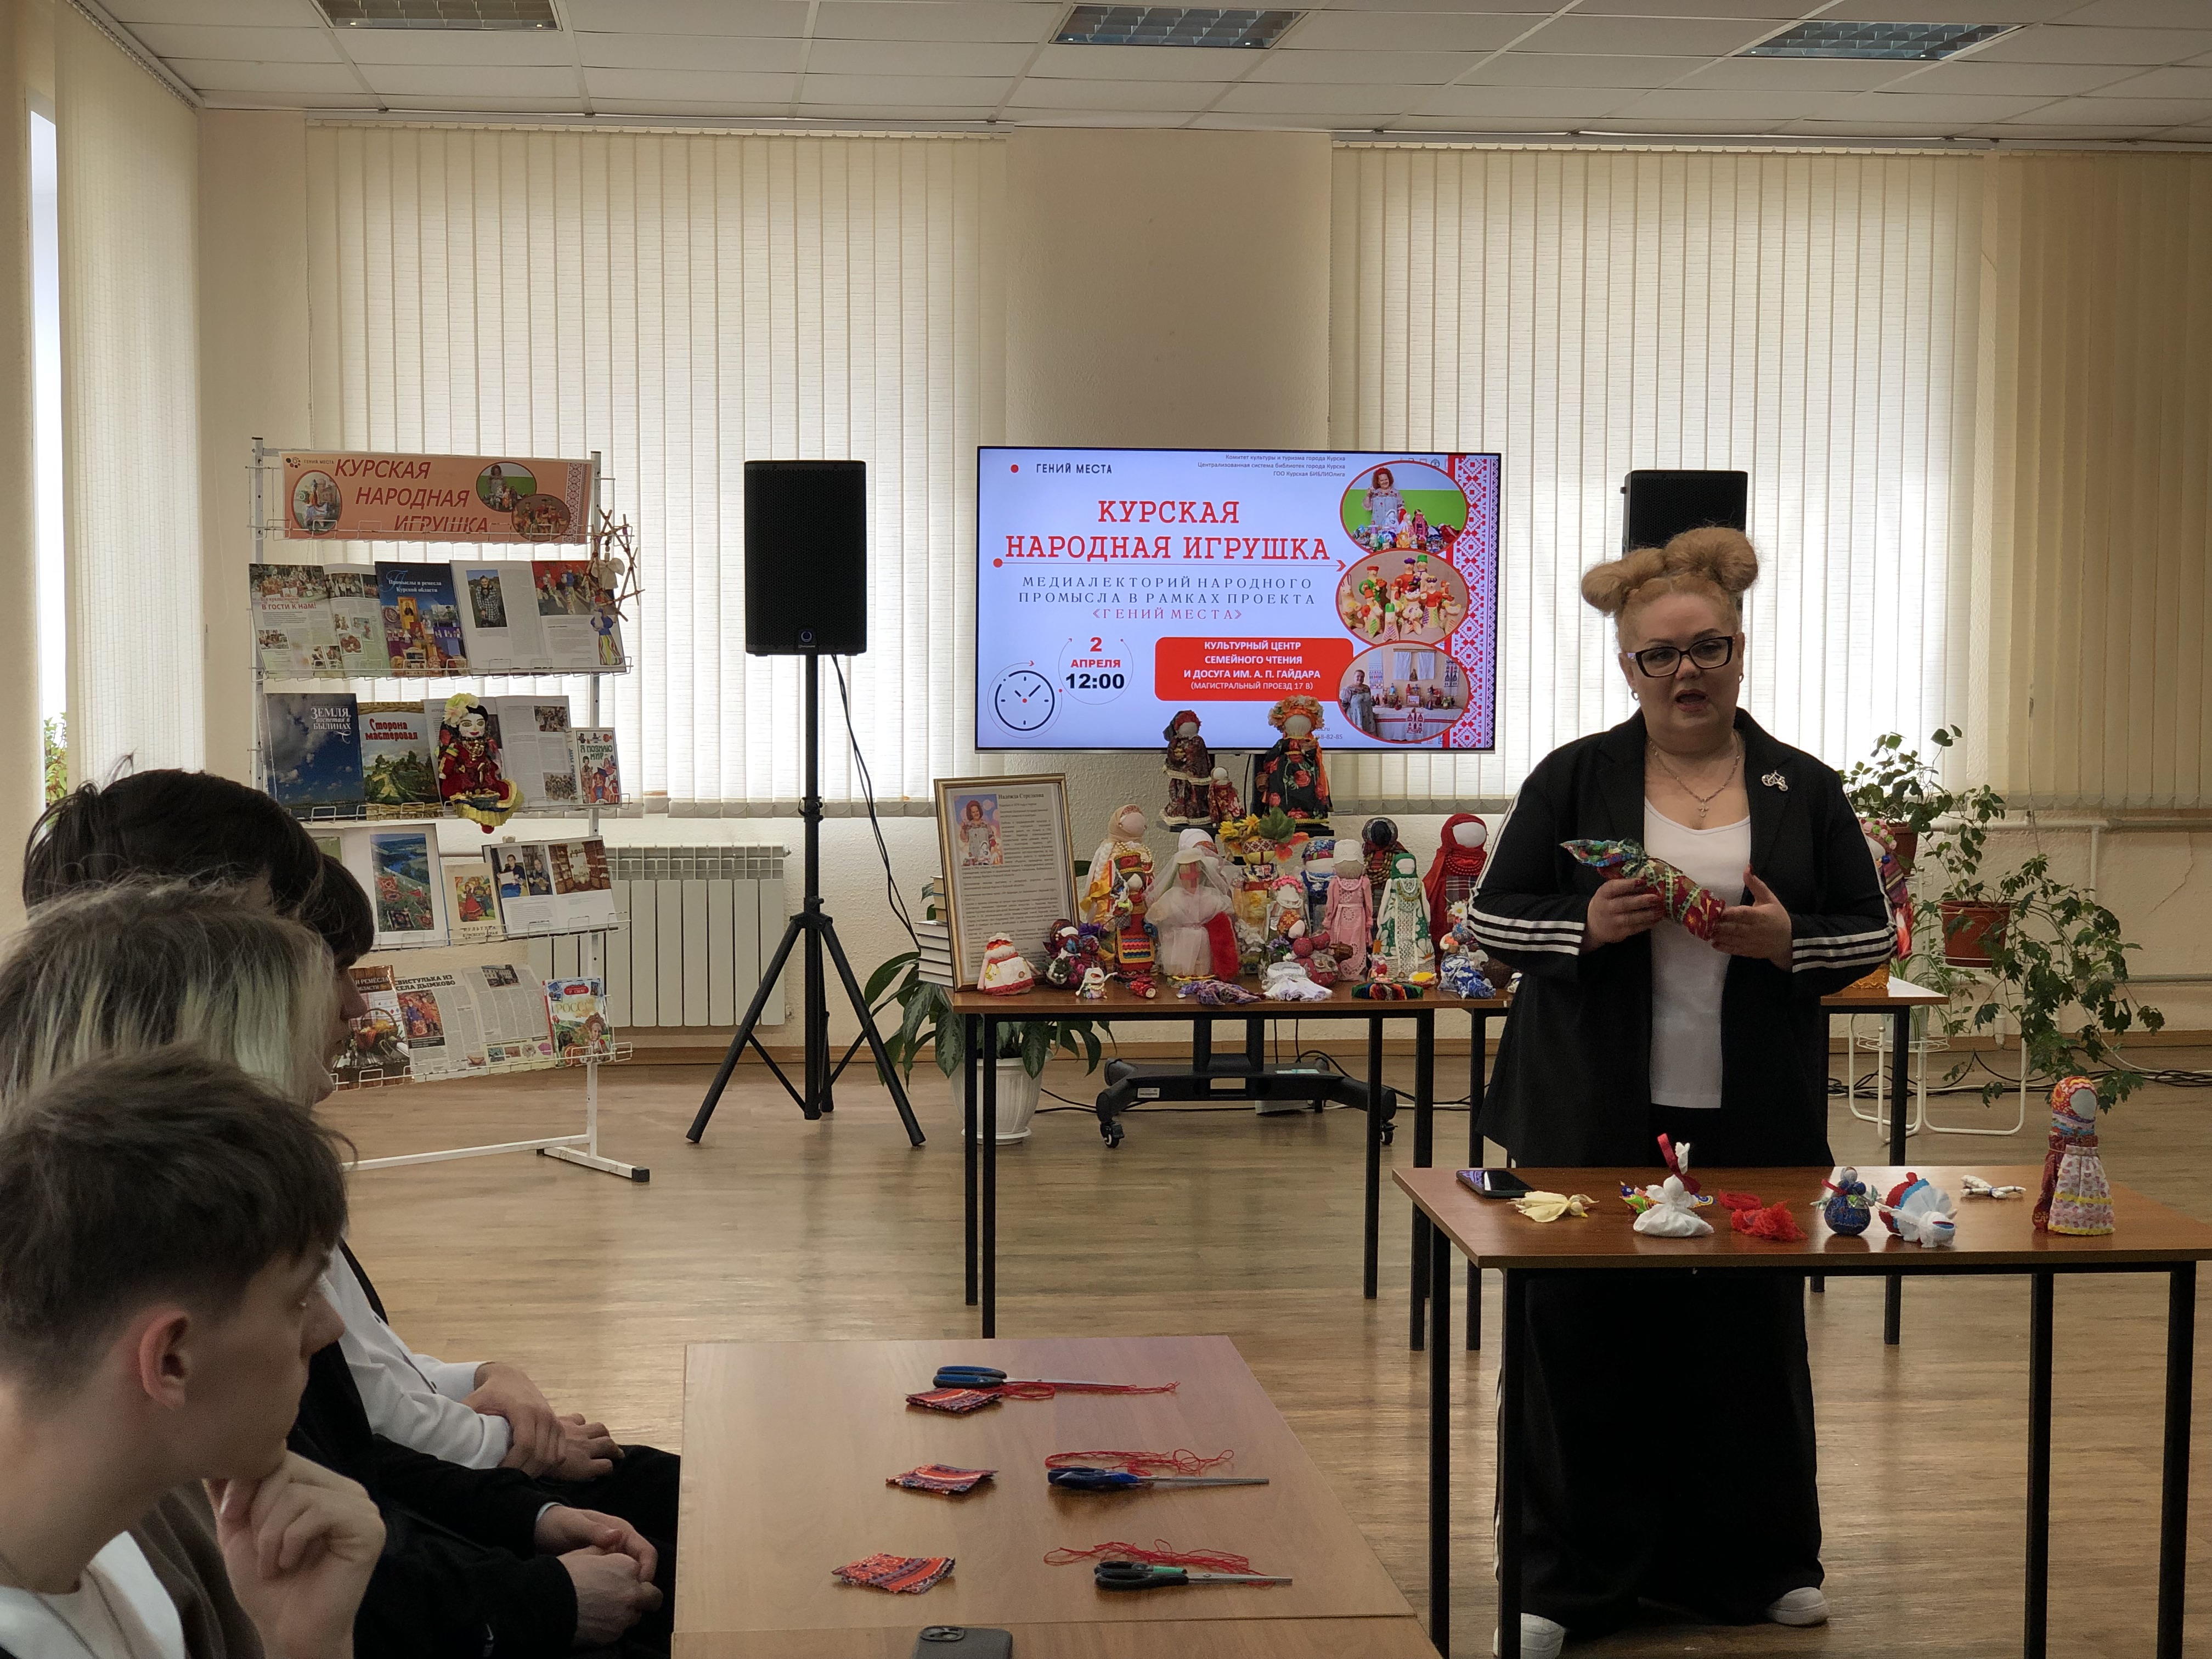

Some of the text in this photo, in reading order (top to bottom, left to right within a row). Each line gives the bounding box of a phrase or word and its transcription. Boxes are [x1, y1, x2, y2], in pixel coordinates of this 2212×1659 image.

[335, 459, 431, 479] КУРСКАЯ
[1036, 462, 1113, 474] ГЕНИЙ МЕСТА
[356, 487, 470, 510] НАРОДНАЯ
[1098, 500, 1240, 523] КУРСКАЯ
[394, 515, 488, 533] ИГРУШКА
[1005, 535, 1330, 562] НАРОДНАЯ ИГРУШКА
[1022, 575, 1312, 590] МЕДИАЛЕКТОРИЙ НАРОДНОГО
[1019, 592, 1315, 605] ПРОМЫСЛА В РАМКАХ ПРОЕКТА
[298, 601, 317, 610] нам!
[1092, 607, 1242, 620] «ГЕНИЙ МЕСТА»
[1090, 637, 1102, 652] 2
[1204, 640, 1301, 652] КУЛЬТУРНЫЙ ЦЕНТР
[1070, 659, 1121, 669] АПРЕЛЯ
[1204, 654, 1302, 665] СЕМЕЙНОГО ЧТЕНИЯ
[1193, 670, 1231, 680] ДОСУГА
[1233, 670, 1253, 679] ИМ.
[1254, 670, 1263, 679] А.
[1265, 671, 1274, 679] П.
[1276, 669, 1321, 680] ГАЙДАРА
[1065, 673, 1125, 690] 12:00
[1190, 681, 1313, 691] (МАГИСТРАЛЬНЫЙ ПРОЕЗД 17 В)
[310, 707, 352, 720] ЗЕМЛЯ,
[369, 718, 408, 732] Сторона
[364, 731, 419, 742] мастеровая
[579, 744, 613, 753] Я ПОЗНАЮ
[590, 752, 604, 760] МИР
[360, 977, 389, 985] РЕМЕСЛА
[417, 980, 456, 990] ДЫМКОВО
